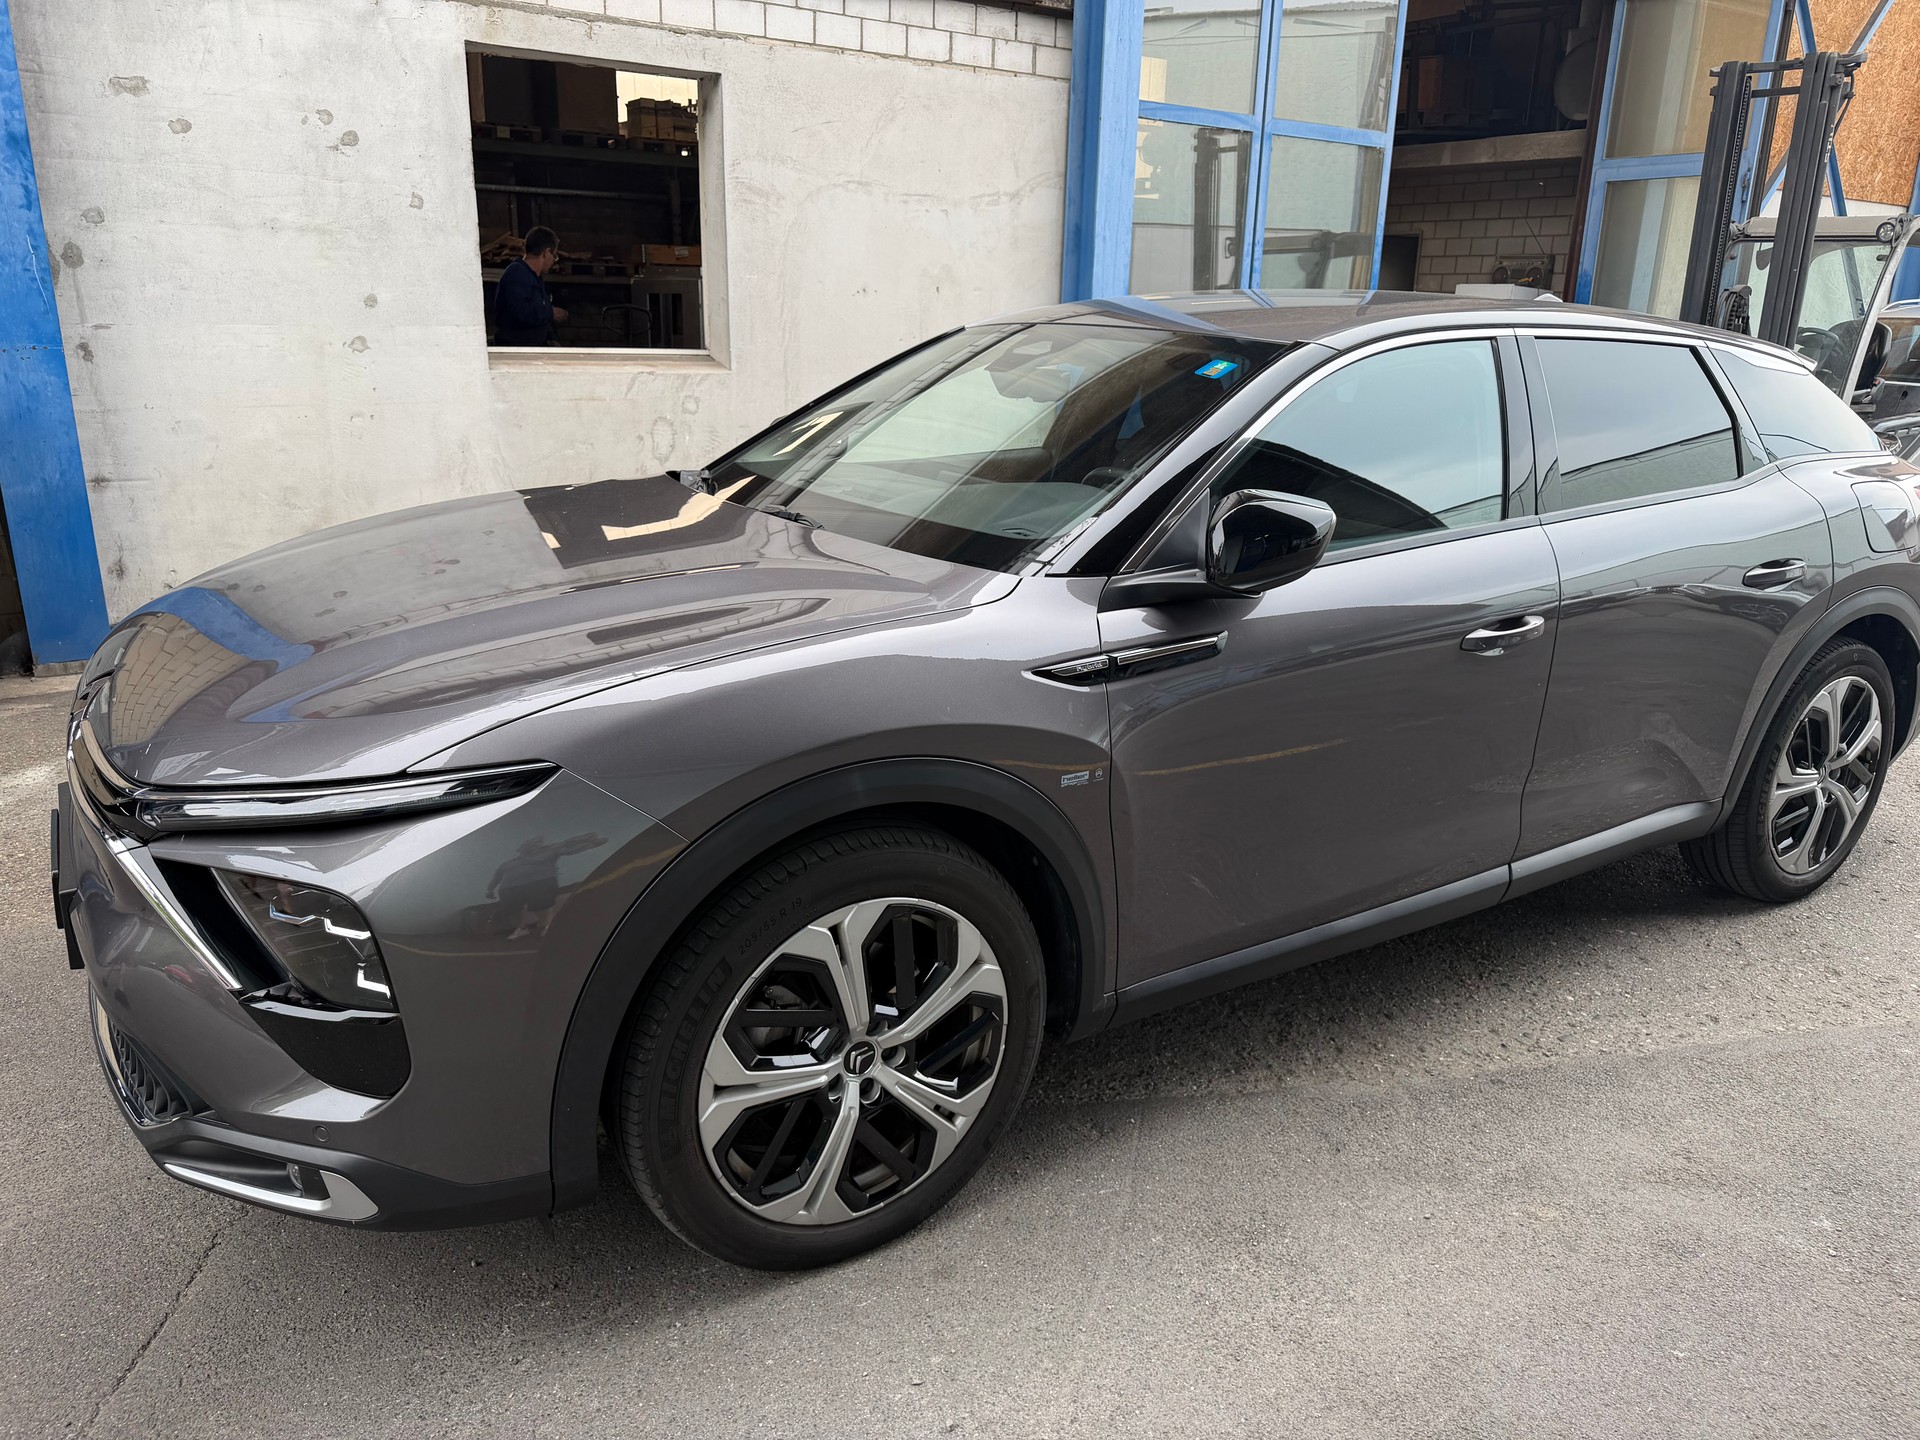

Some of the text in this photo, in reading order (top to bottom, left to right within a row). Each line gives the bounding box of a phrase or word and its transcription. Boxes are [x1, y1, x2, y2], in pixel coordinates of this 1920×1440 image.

[738, 897, 802, 956] 205/55 R 19
[659, 964, 728, 1121] MICHELIN
